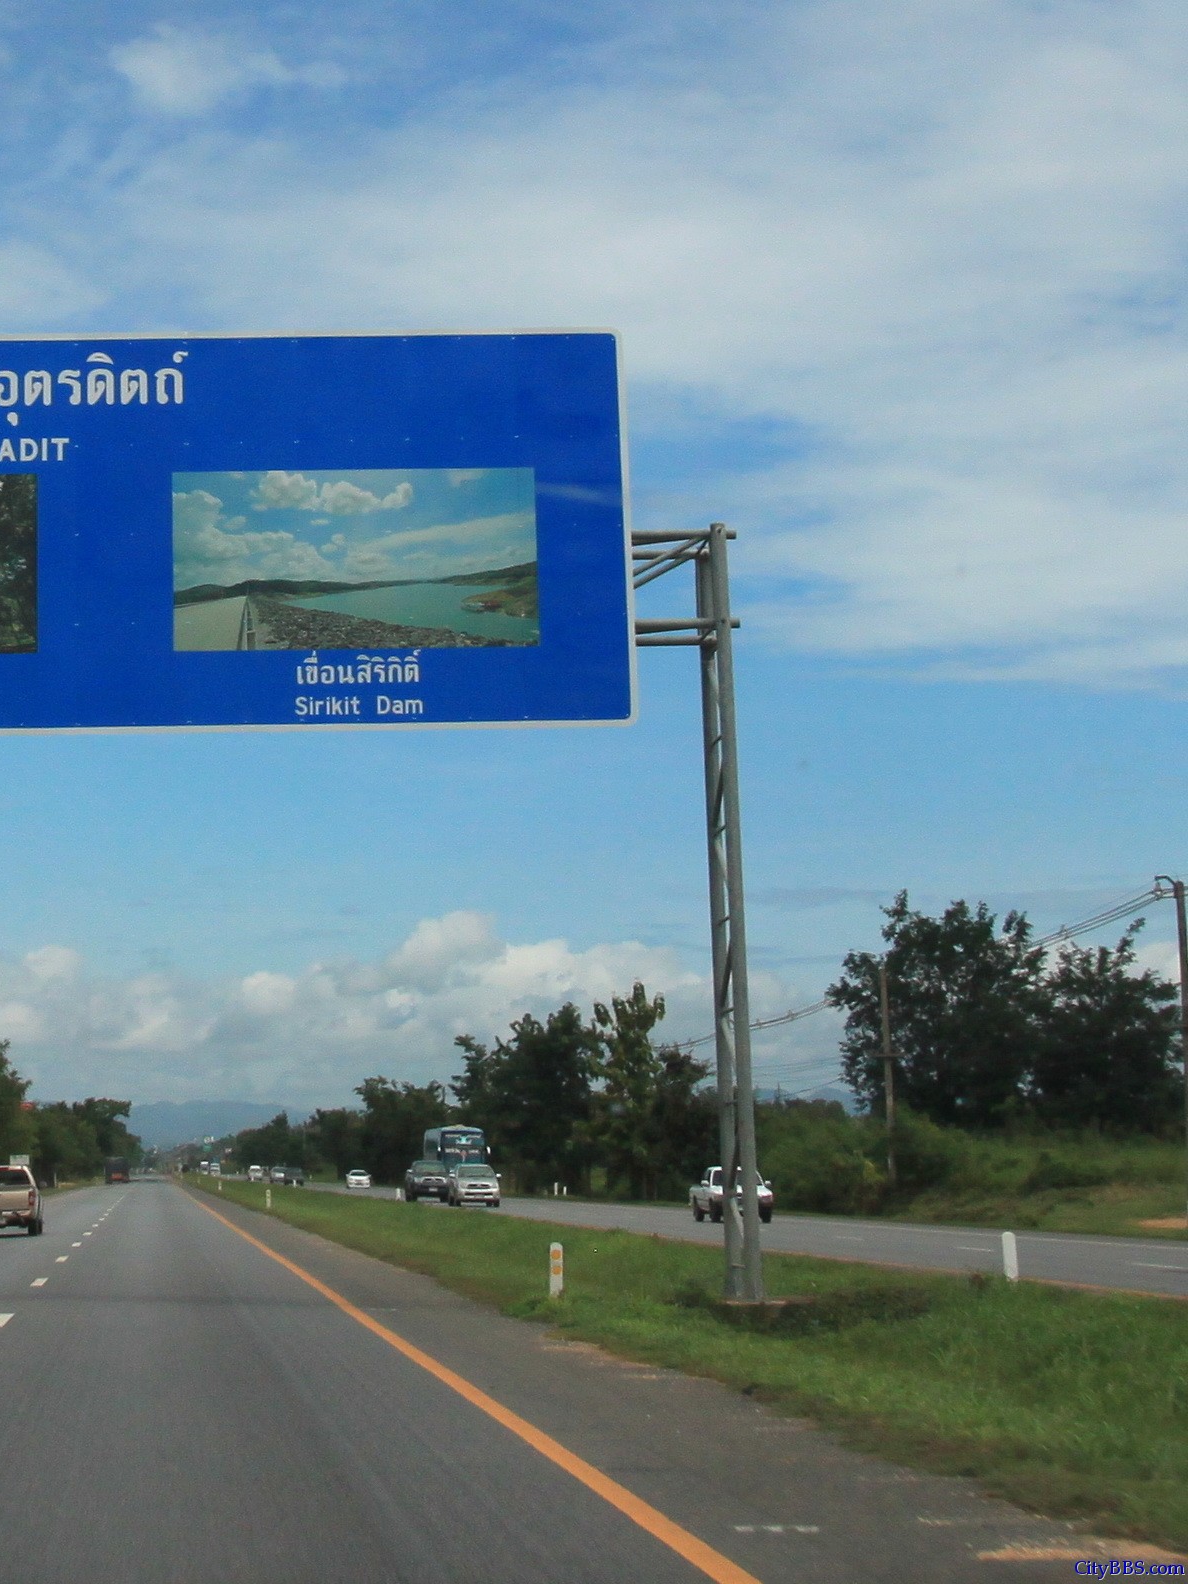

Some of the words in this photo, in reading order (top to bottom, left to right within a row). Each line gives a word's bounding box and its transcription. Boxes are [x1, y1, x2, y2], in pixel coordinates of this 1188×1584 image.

[296, 649, 422, 684] เขื่อนสิริกิติ์
[294, 695, 361, 716] Sirikit
[376, 695, 424, 715] Dam
